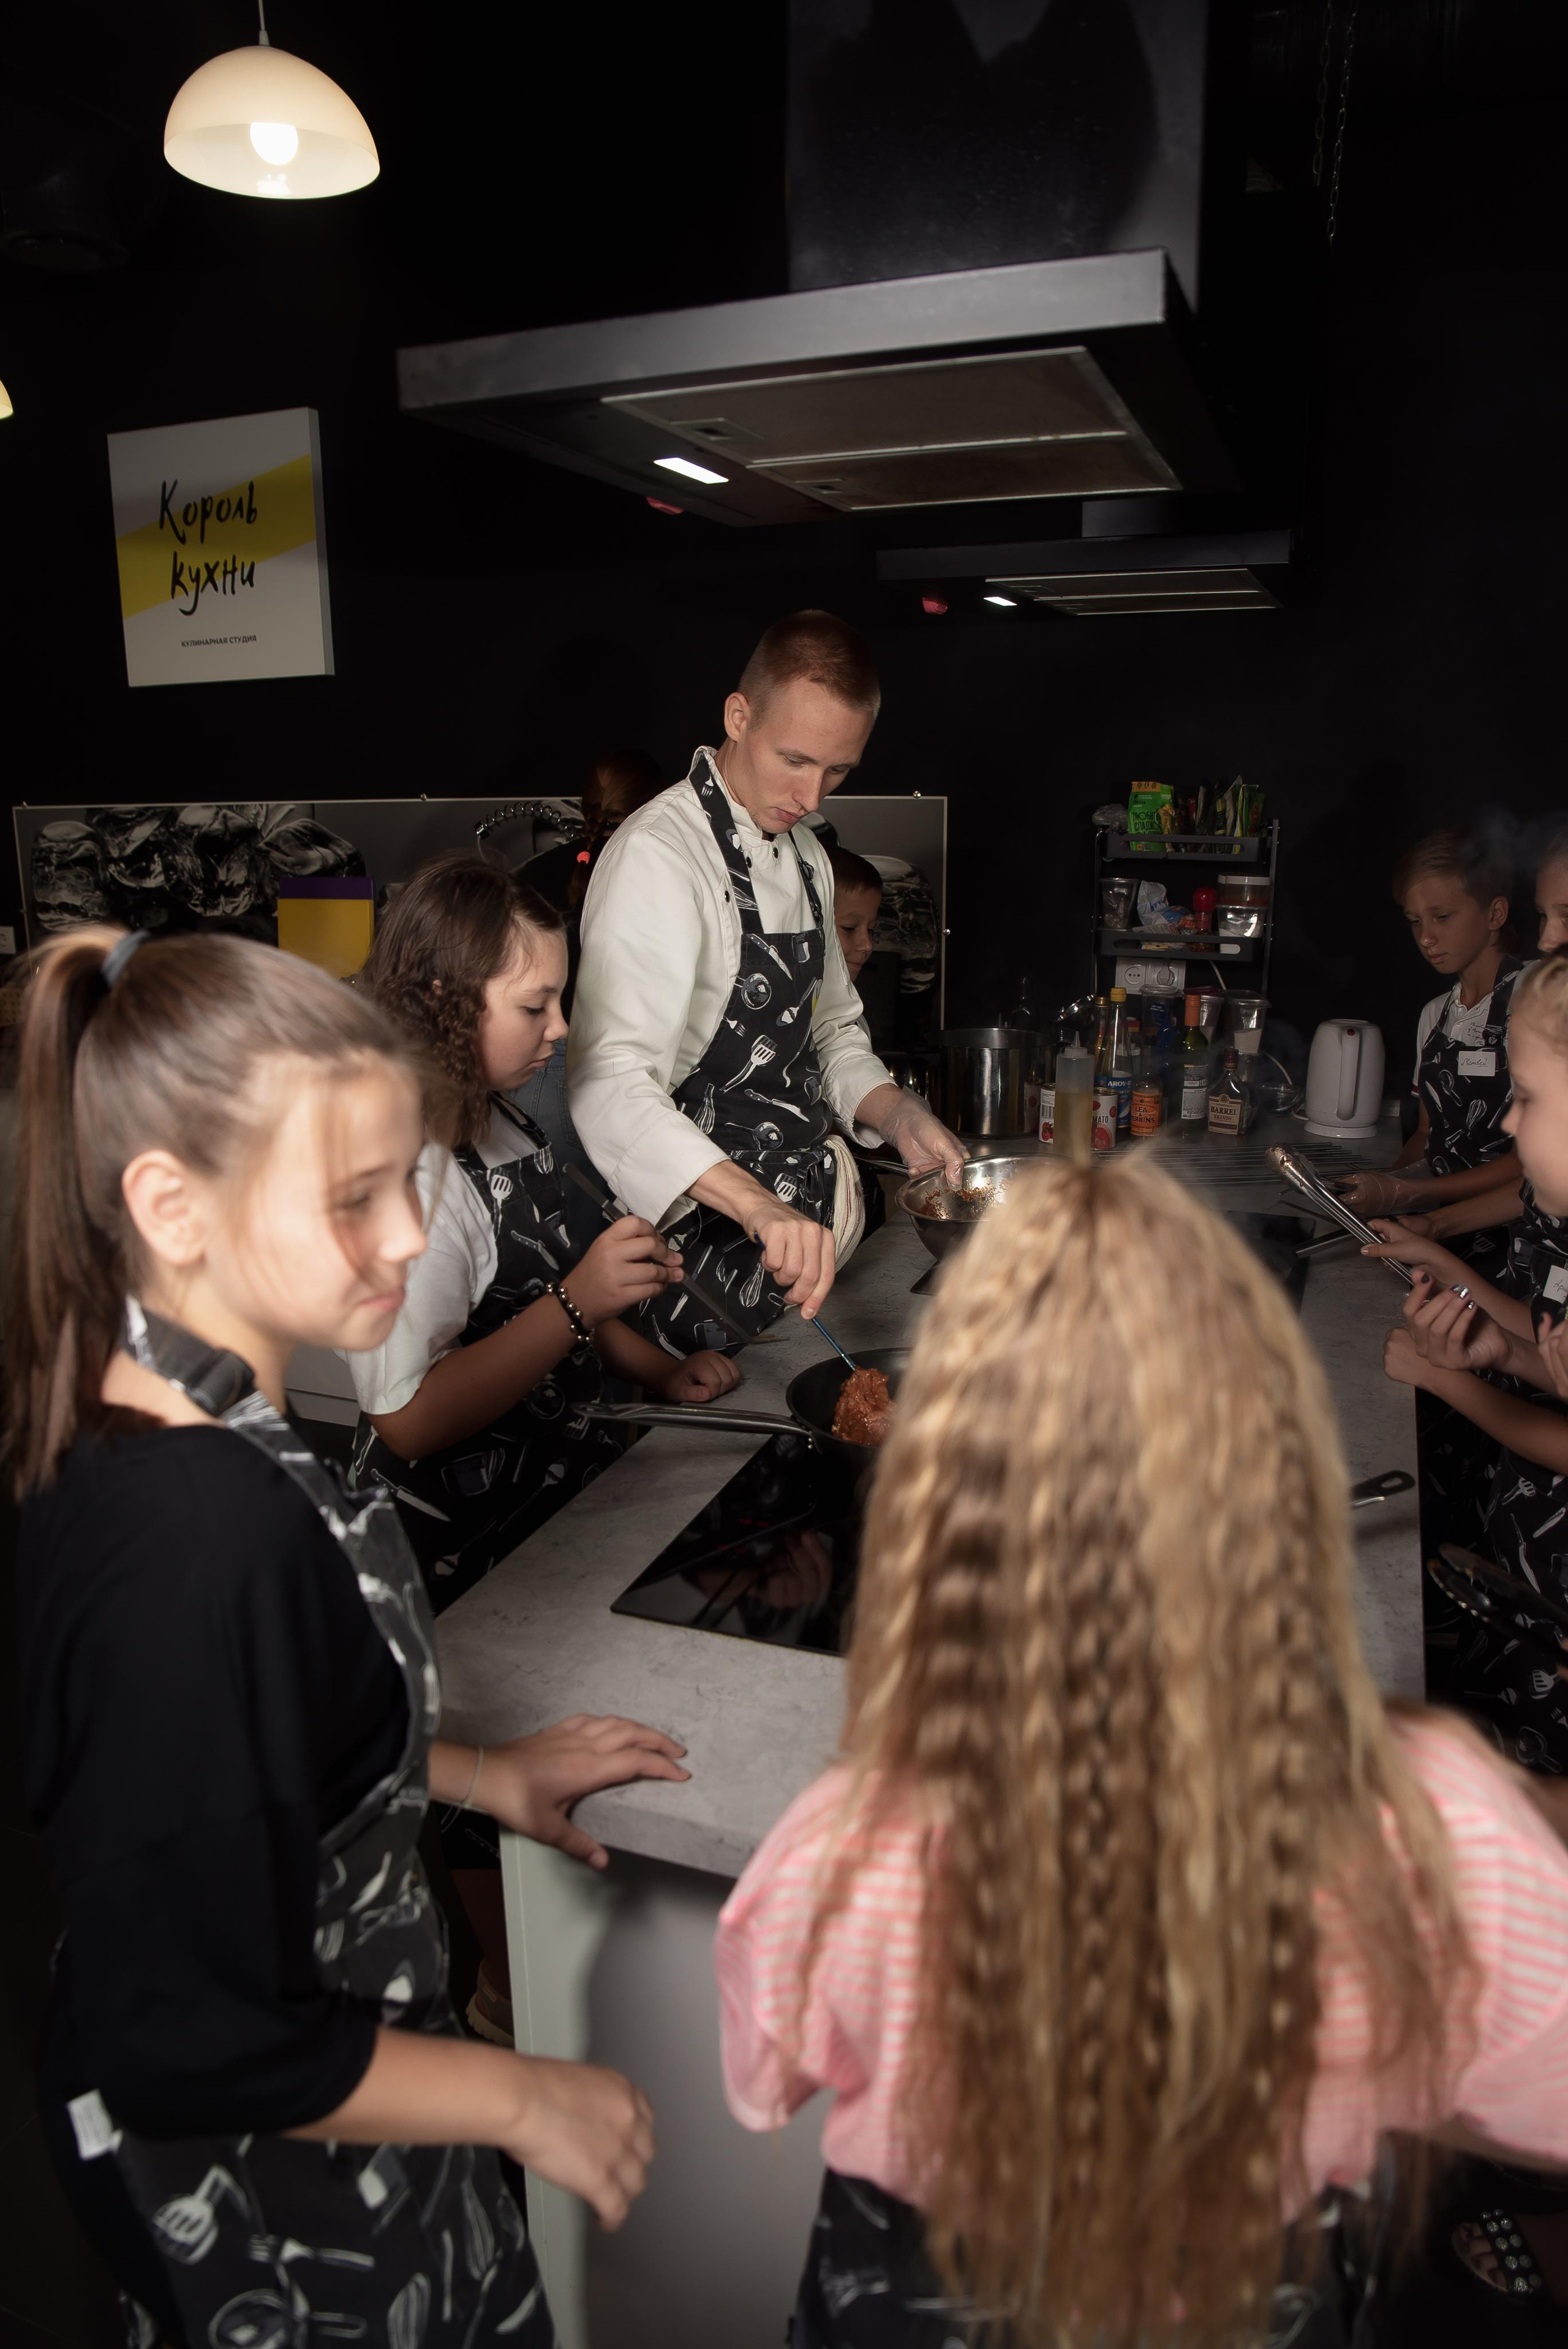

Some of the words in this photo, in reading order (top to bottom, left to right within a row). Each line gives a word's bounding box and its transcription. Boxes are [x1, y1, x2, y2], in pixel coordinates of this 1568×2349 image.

[159, 480, 257, 545] Король
[171, 550, 255, 616] кухни
[181, 637, 228, 647] КУЛИНАРНАЯ
[229, 635, 257, 644] СТУДИЯ
[1210, 1106, 1237, 1115] BARREL
